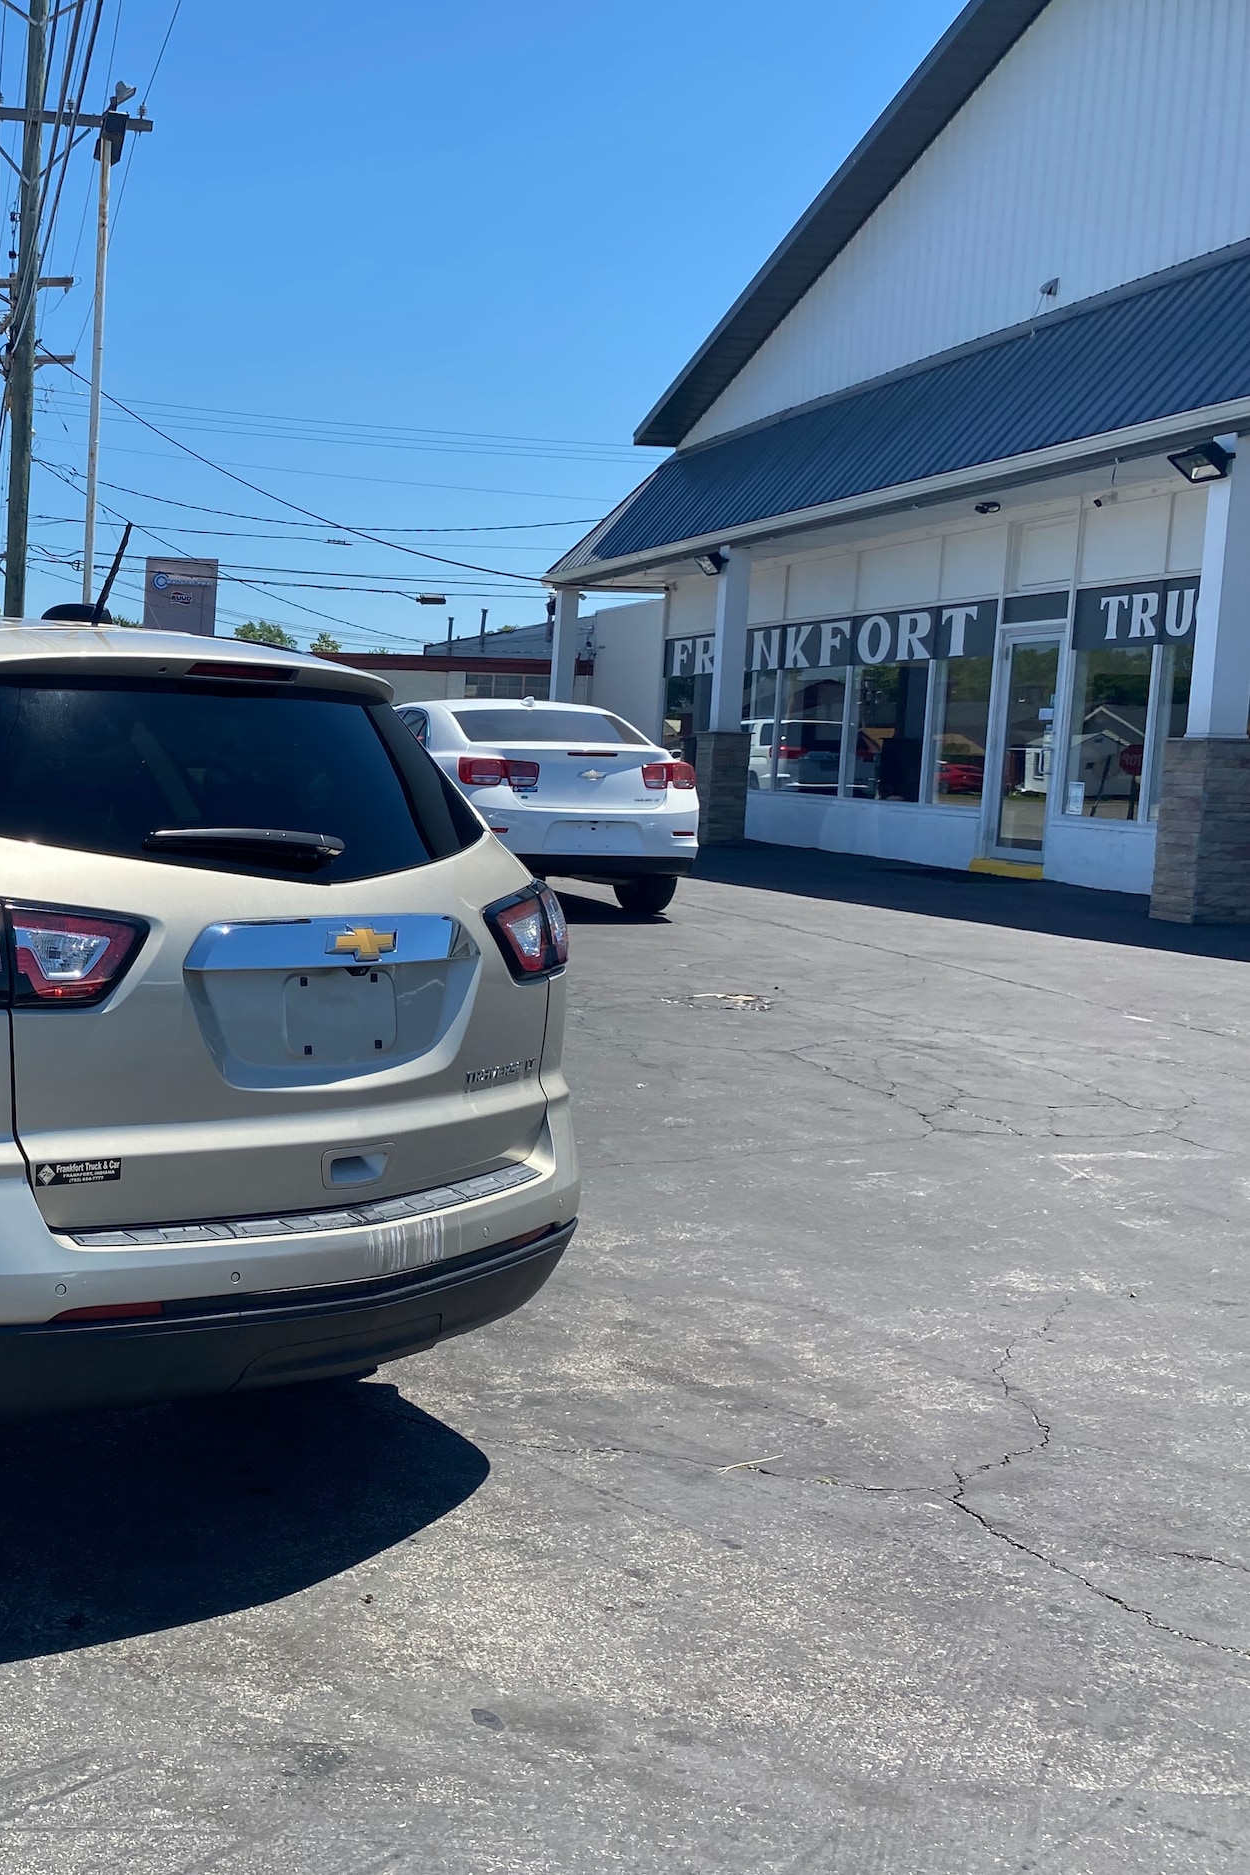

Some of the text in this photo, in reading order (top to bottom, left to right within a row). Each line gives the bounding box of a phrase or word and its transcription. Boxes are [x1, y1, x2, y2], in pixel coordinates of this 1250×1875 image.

[671, 588, 1200, 677] FRNKFORT TRU
[56, 1159, 120, 1174] Frankfort Truck & Car
